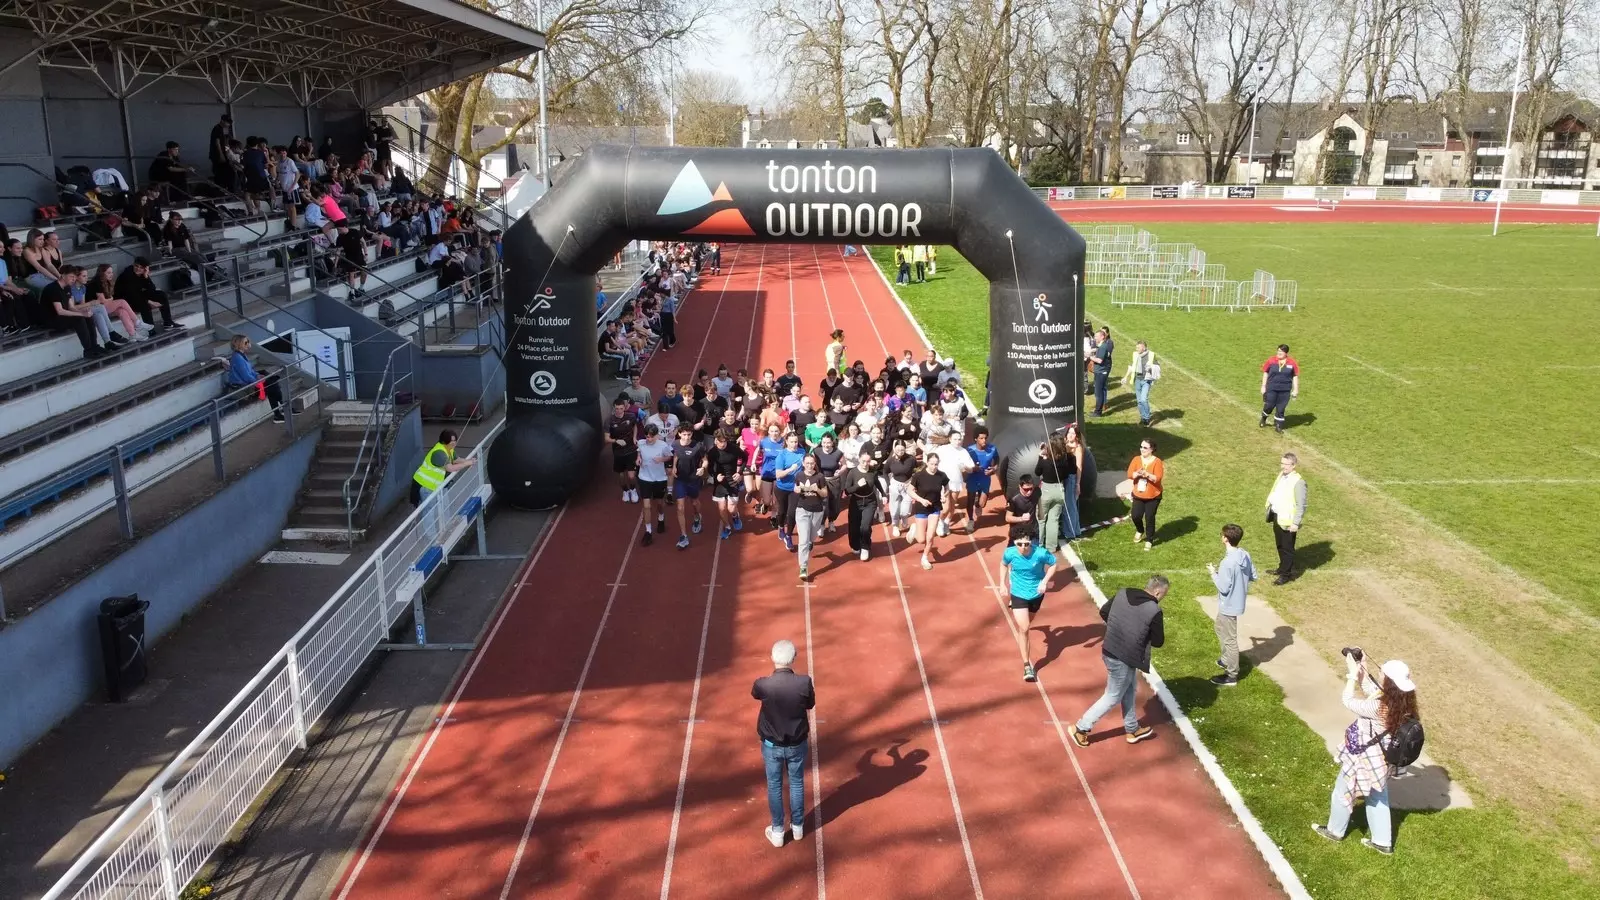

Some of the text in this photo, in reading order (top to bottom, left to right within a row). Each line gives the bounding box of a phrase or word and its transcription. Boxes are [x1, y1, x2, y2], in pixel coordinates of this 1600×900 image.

[766, 160, 876, 193] tonton
[766, 202, 922, 236] OUTDOOR
[513, 314, 571, 326] Tonton Outdoor
[1012, 322, 1071, 333] Tonton Outdoor
[1012, 343, 1038, 352] Running
[514, 396, 578, 405] www.tonton-outdoor.com
[1008, 405, 1074, 414] www.tonton-outdoor.com
